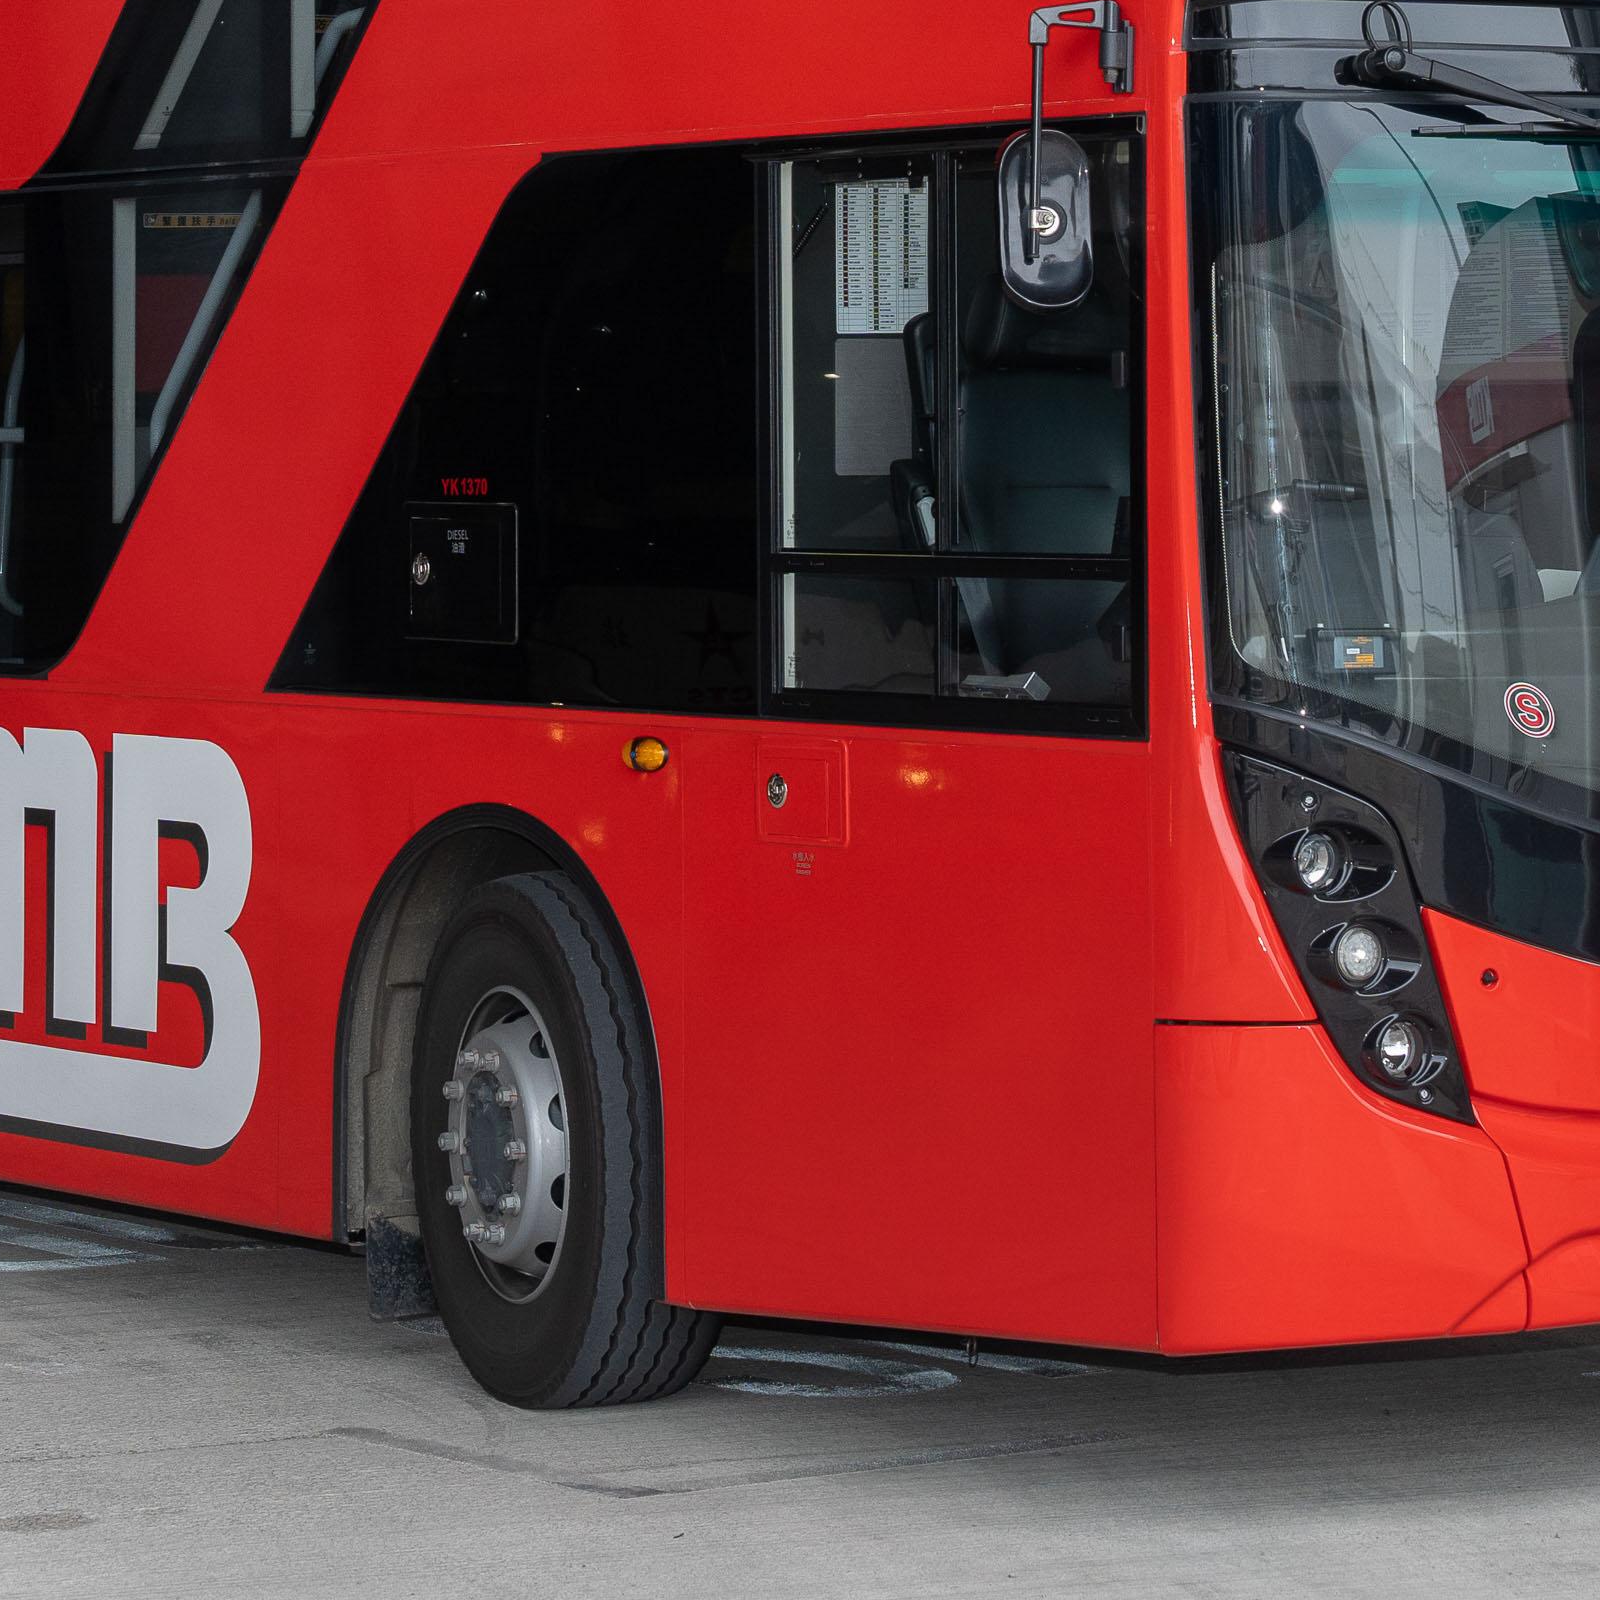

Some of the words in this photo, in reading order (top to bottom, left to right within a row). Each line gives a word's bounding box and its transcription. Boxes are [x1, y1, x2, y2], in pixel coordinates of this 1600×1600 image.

[441, 478, 460, 496] YK
[461, 478, 488, 496] 1370
[447, 529, 469, 541] DIESEL
